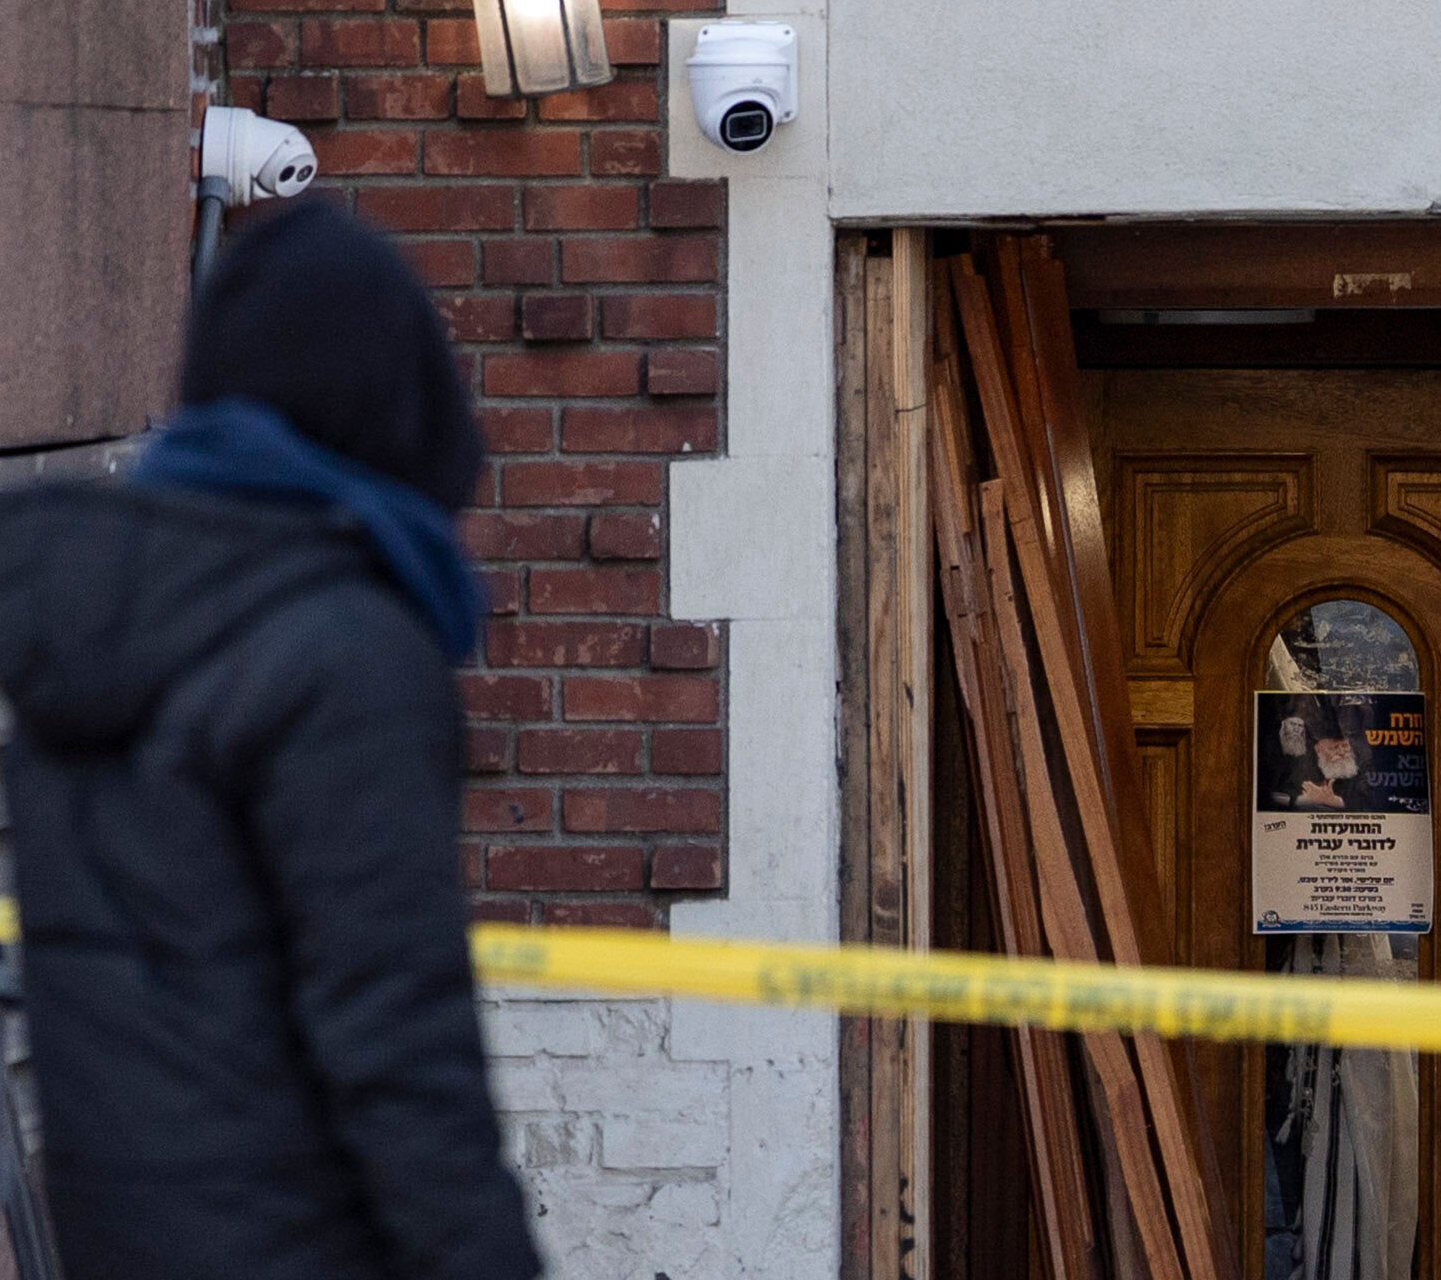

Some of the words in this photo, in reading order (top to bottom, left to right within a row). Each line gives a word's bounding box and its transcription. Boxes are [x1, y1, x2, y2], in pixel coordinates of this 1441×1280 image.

[1364, 729, 1423, 746] השמש
[1365, 771, 1424, 787] השמש
[1310, 822, 1382, 835] התוועדות
[1296, 837, 1344, 851] עברית
[1347, 837, 1396, 850] לדוברי
